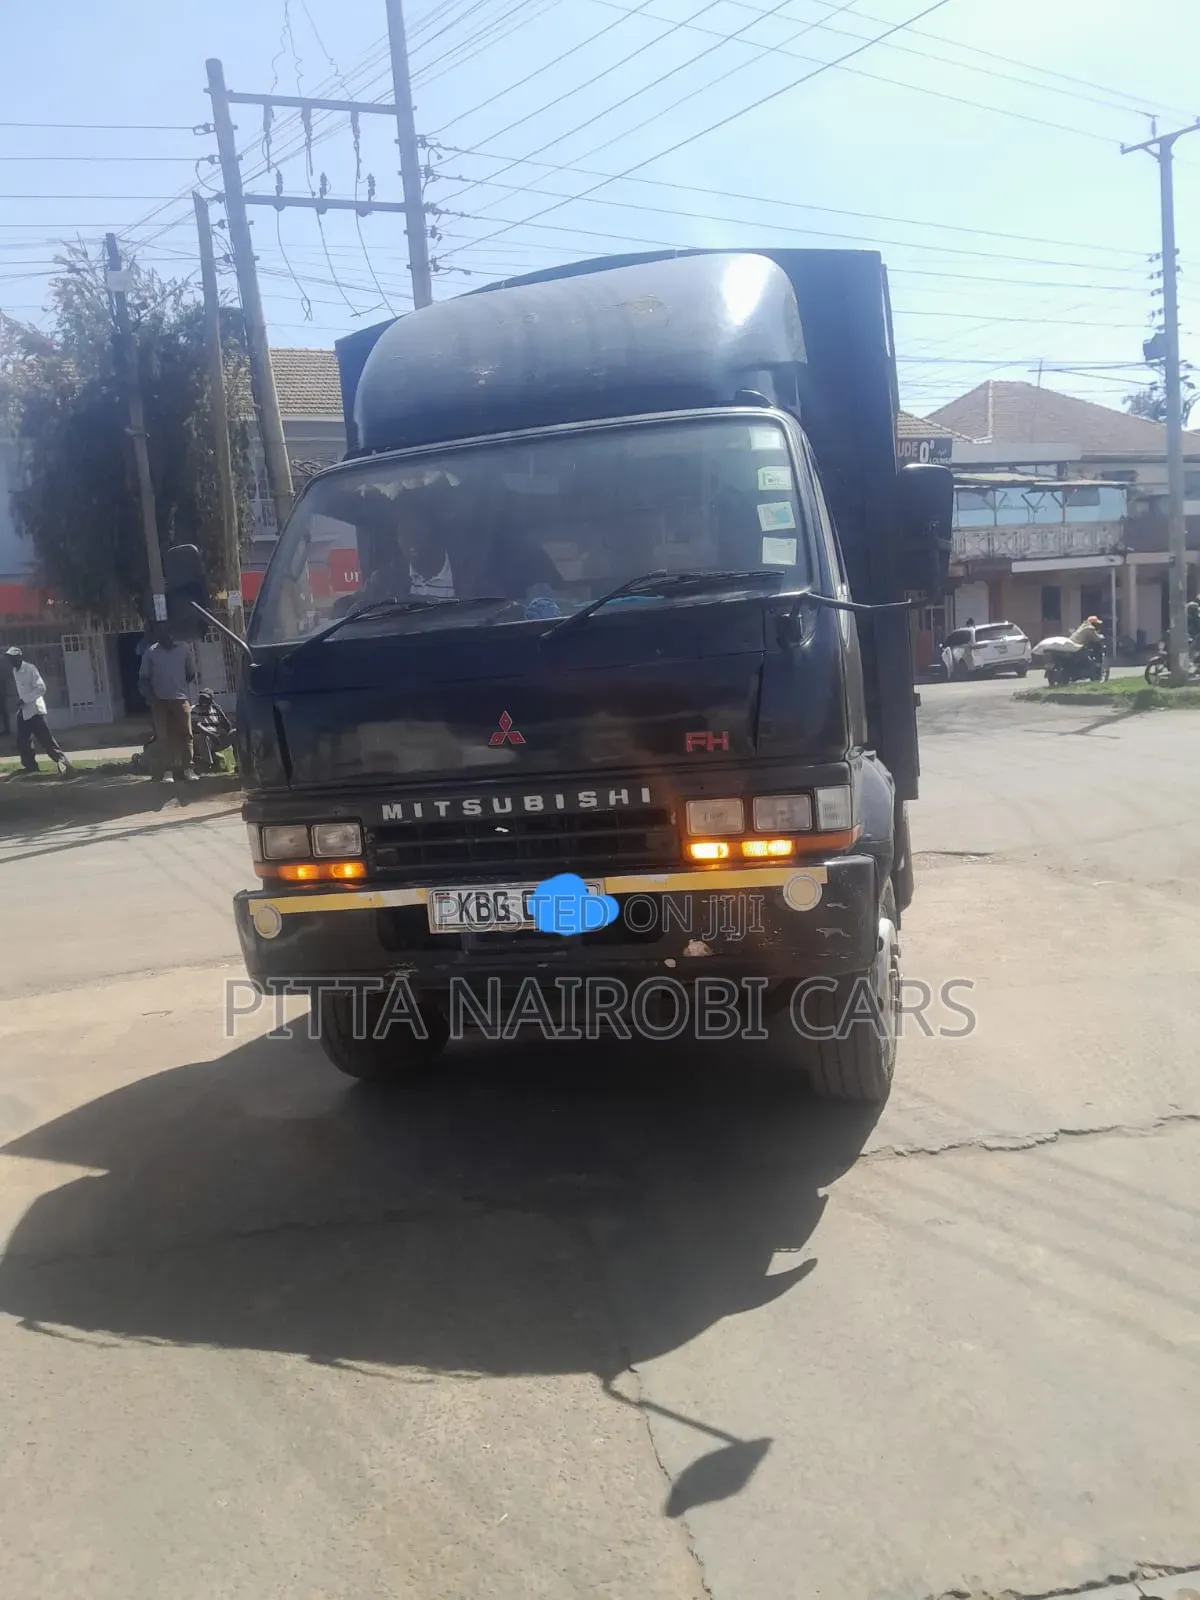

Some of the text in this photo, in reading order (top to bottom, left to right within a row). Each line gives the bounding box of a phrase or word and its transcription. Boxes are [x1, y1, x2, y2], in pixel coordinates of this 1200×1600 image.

[685, 731, 729, 752] FH
[382, 787, 651, 821] MITSUBISHI
[457, 891, 511, 923] KBG
